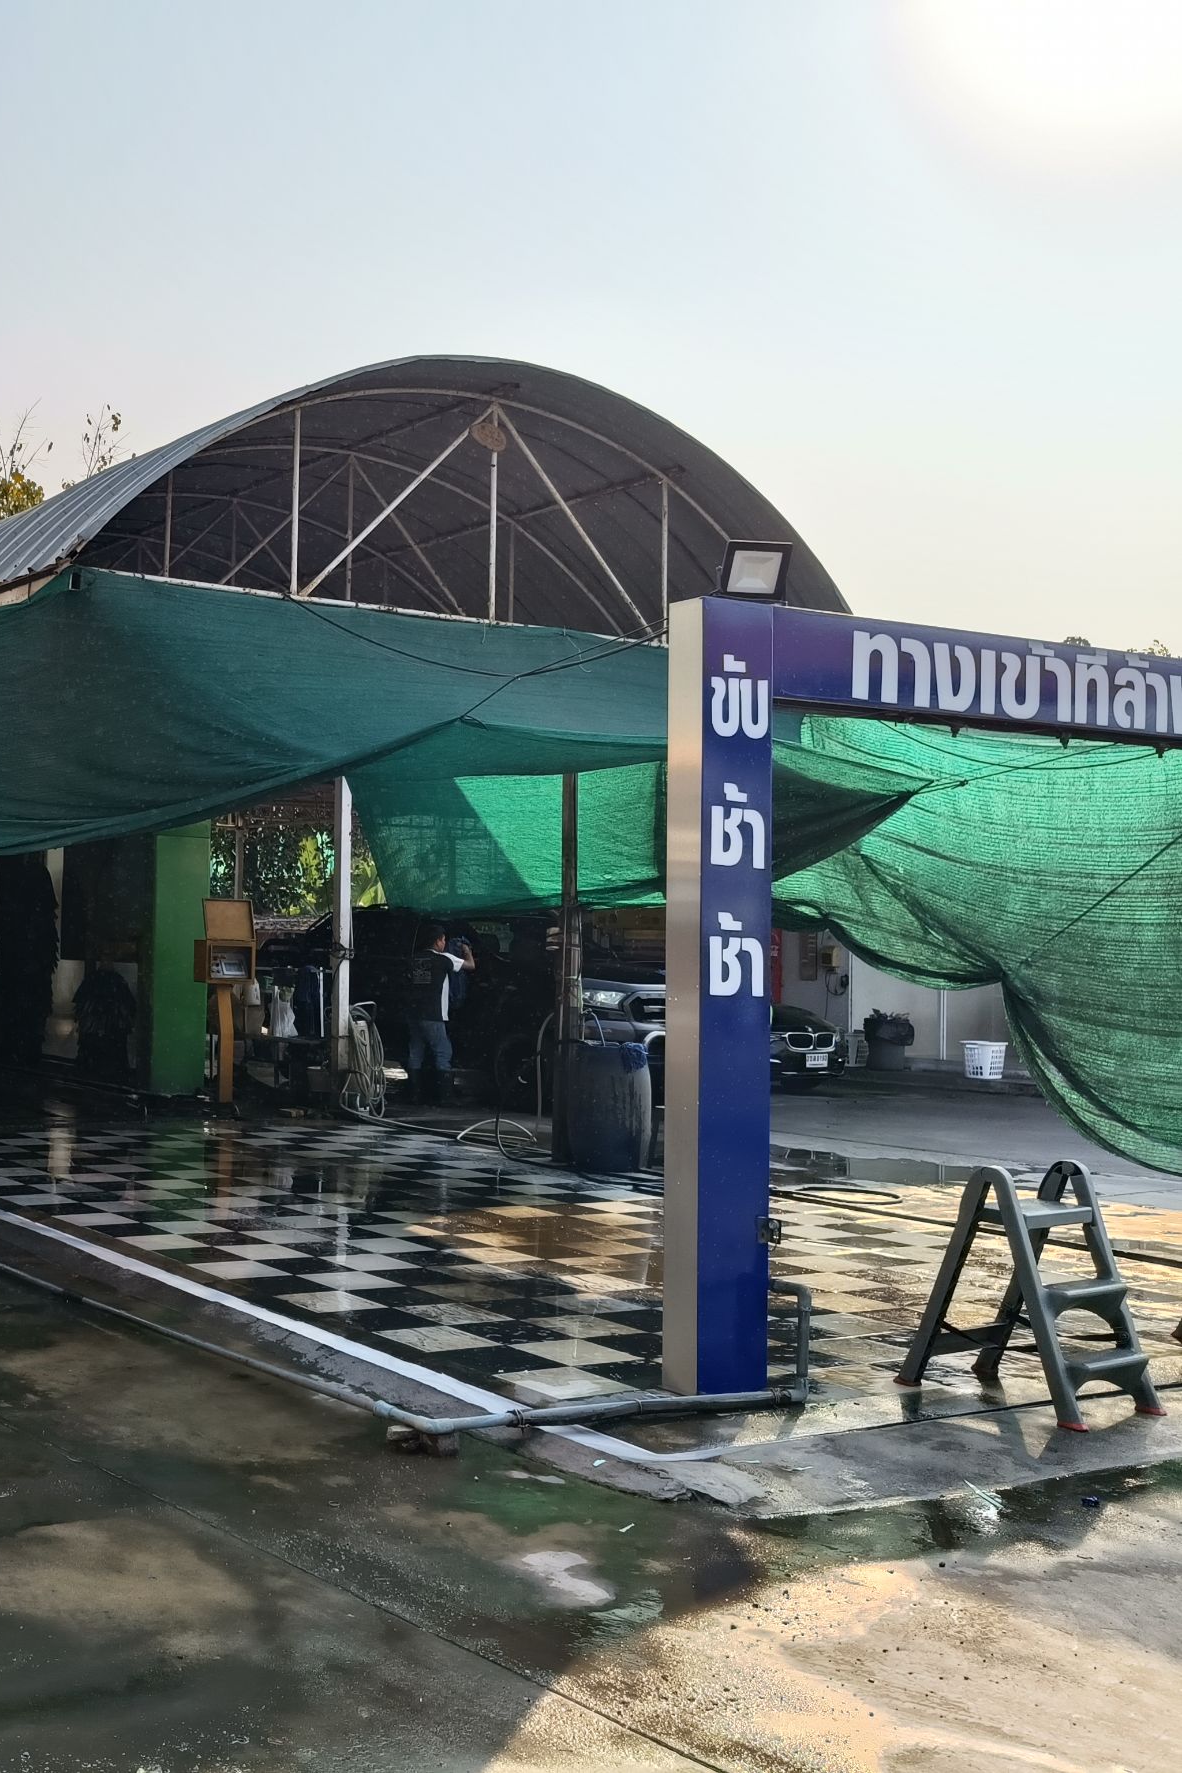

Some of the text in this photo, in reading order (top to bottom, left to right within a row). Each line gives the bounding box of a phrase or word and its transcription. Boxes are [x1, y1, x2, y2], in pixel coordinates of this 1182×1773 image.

[852, 630, 1182, 734] ทางเข้าที่ล้า
[709, 654, 768, 998] ขับ ช้า ช้า
